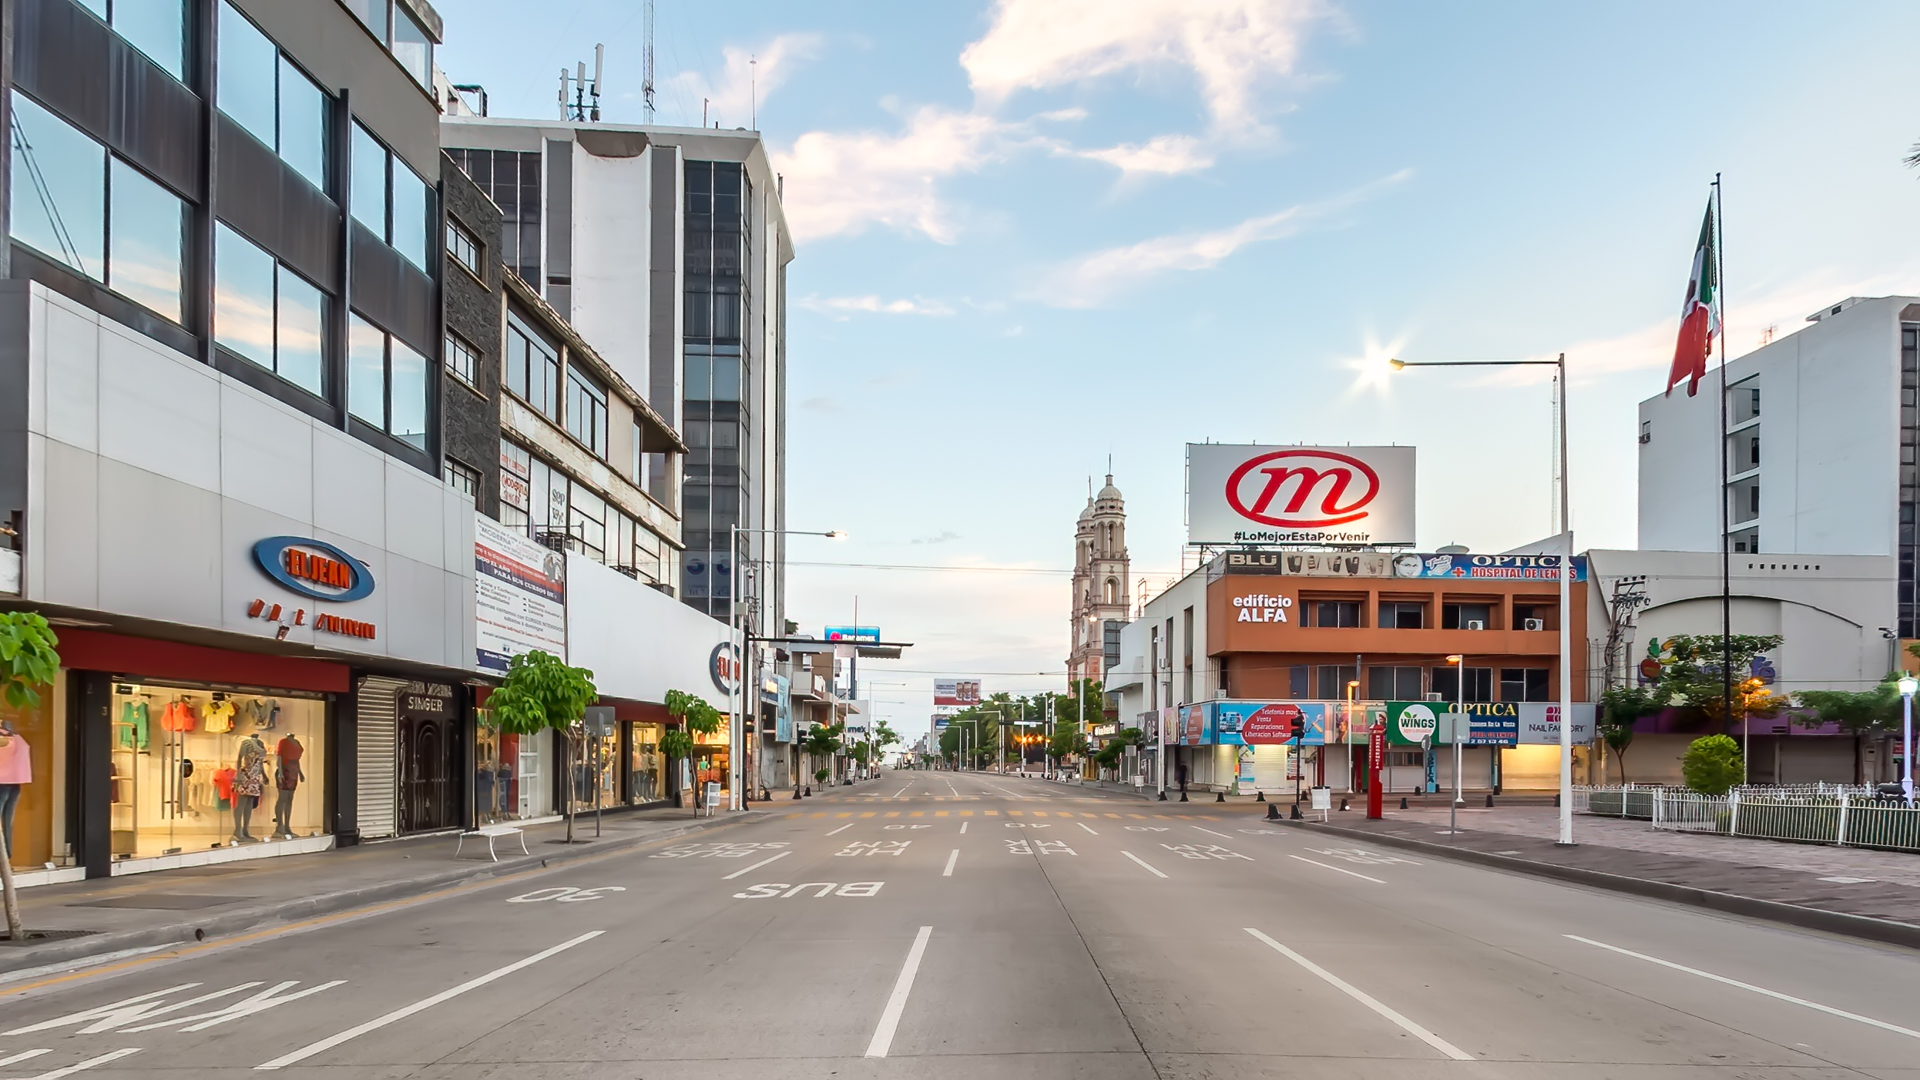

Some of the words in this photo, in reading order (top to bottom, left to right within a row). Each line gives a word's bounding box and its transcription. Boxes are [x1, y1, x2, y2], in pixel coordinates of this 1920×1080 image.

[1233, 531, 1370, 544] #LoMejorEstaPorVenir
[1471, 567, 1522, 579] HOSPITAL
[1524, 569, 1538, 579] DE
[1233, 594, 1292, 608] edificio
[1237, 608, 1288, 623] ALFA
[408, 696, 443, 712] SINGER
[1250, 723, 1284, 731] Reparaciones
[1400, 718, 1436, 729] WINGS
[1529, 723, 1548, 733] NAIL
[845, 840, 913, 848] KM
[834, 847, 906, 857] HR
[1009, 846, 1079, 857] HR
[506, 886, 627, 903] 30
[731, 881, 886, 900] BUS
